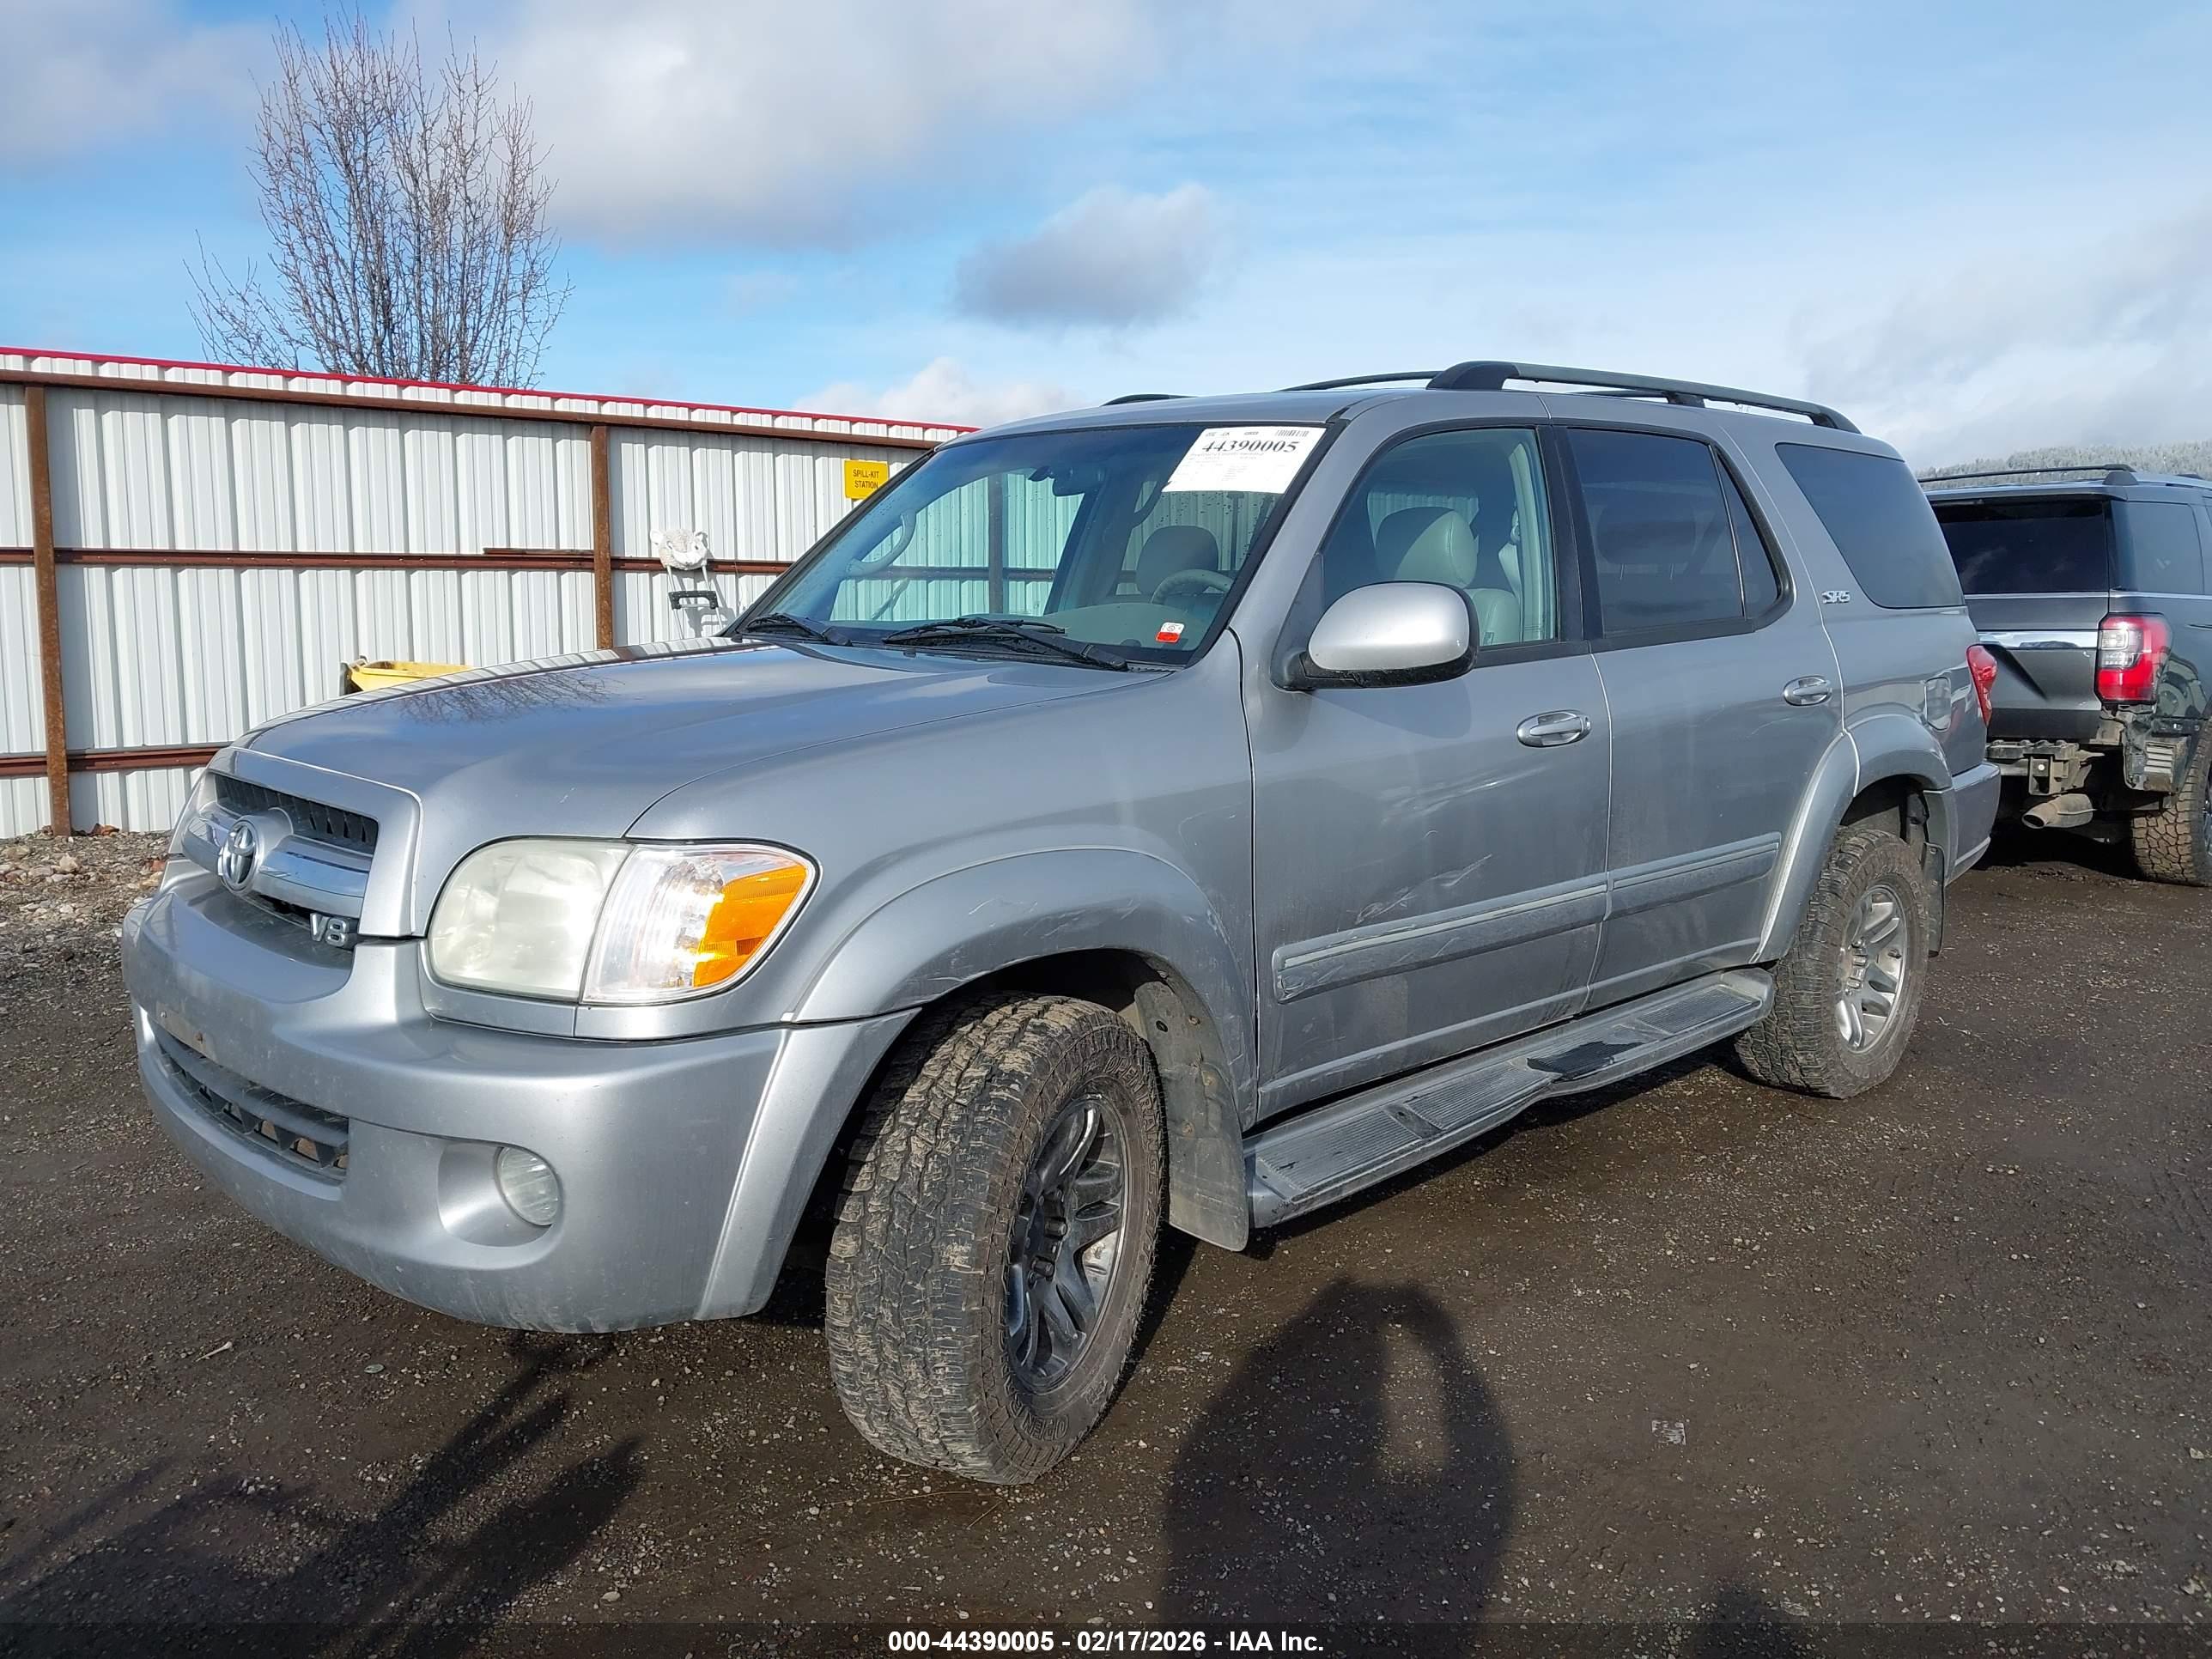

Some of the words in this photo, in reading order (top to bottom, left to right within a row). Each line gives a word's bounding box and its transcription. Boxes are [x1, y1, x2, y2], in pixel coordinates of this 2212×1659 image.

[1202, 440, 1300, 453] 44390005
[853, 469, 880, 478] SPILL-KIT
[854, 480, 878, 489] STATION
[310, 913, 350, 947] V8
[1103, 1054, 1145, 1093] OPEN
[1135, 1093, 1160, 1195] RANGE
[1021, 1409, 1069, 1443] OPEN
